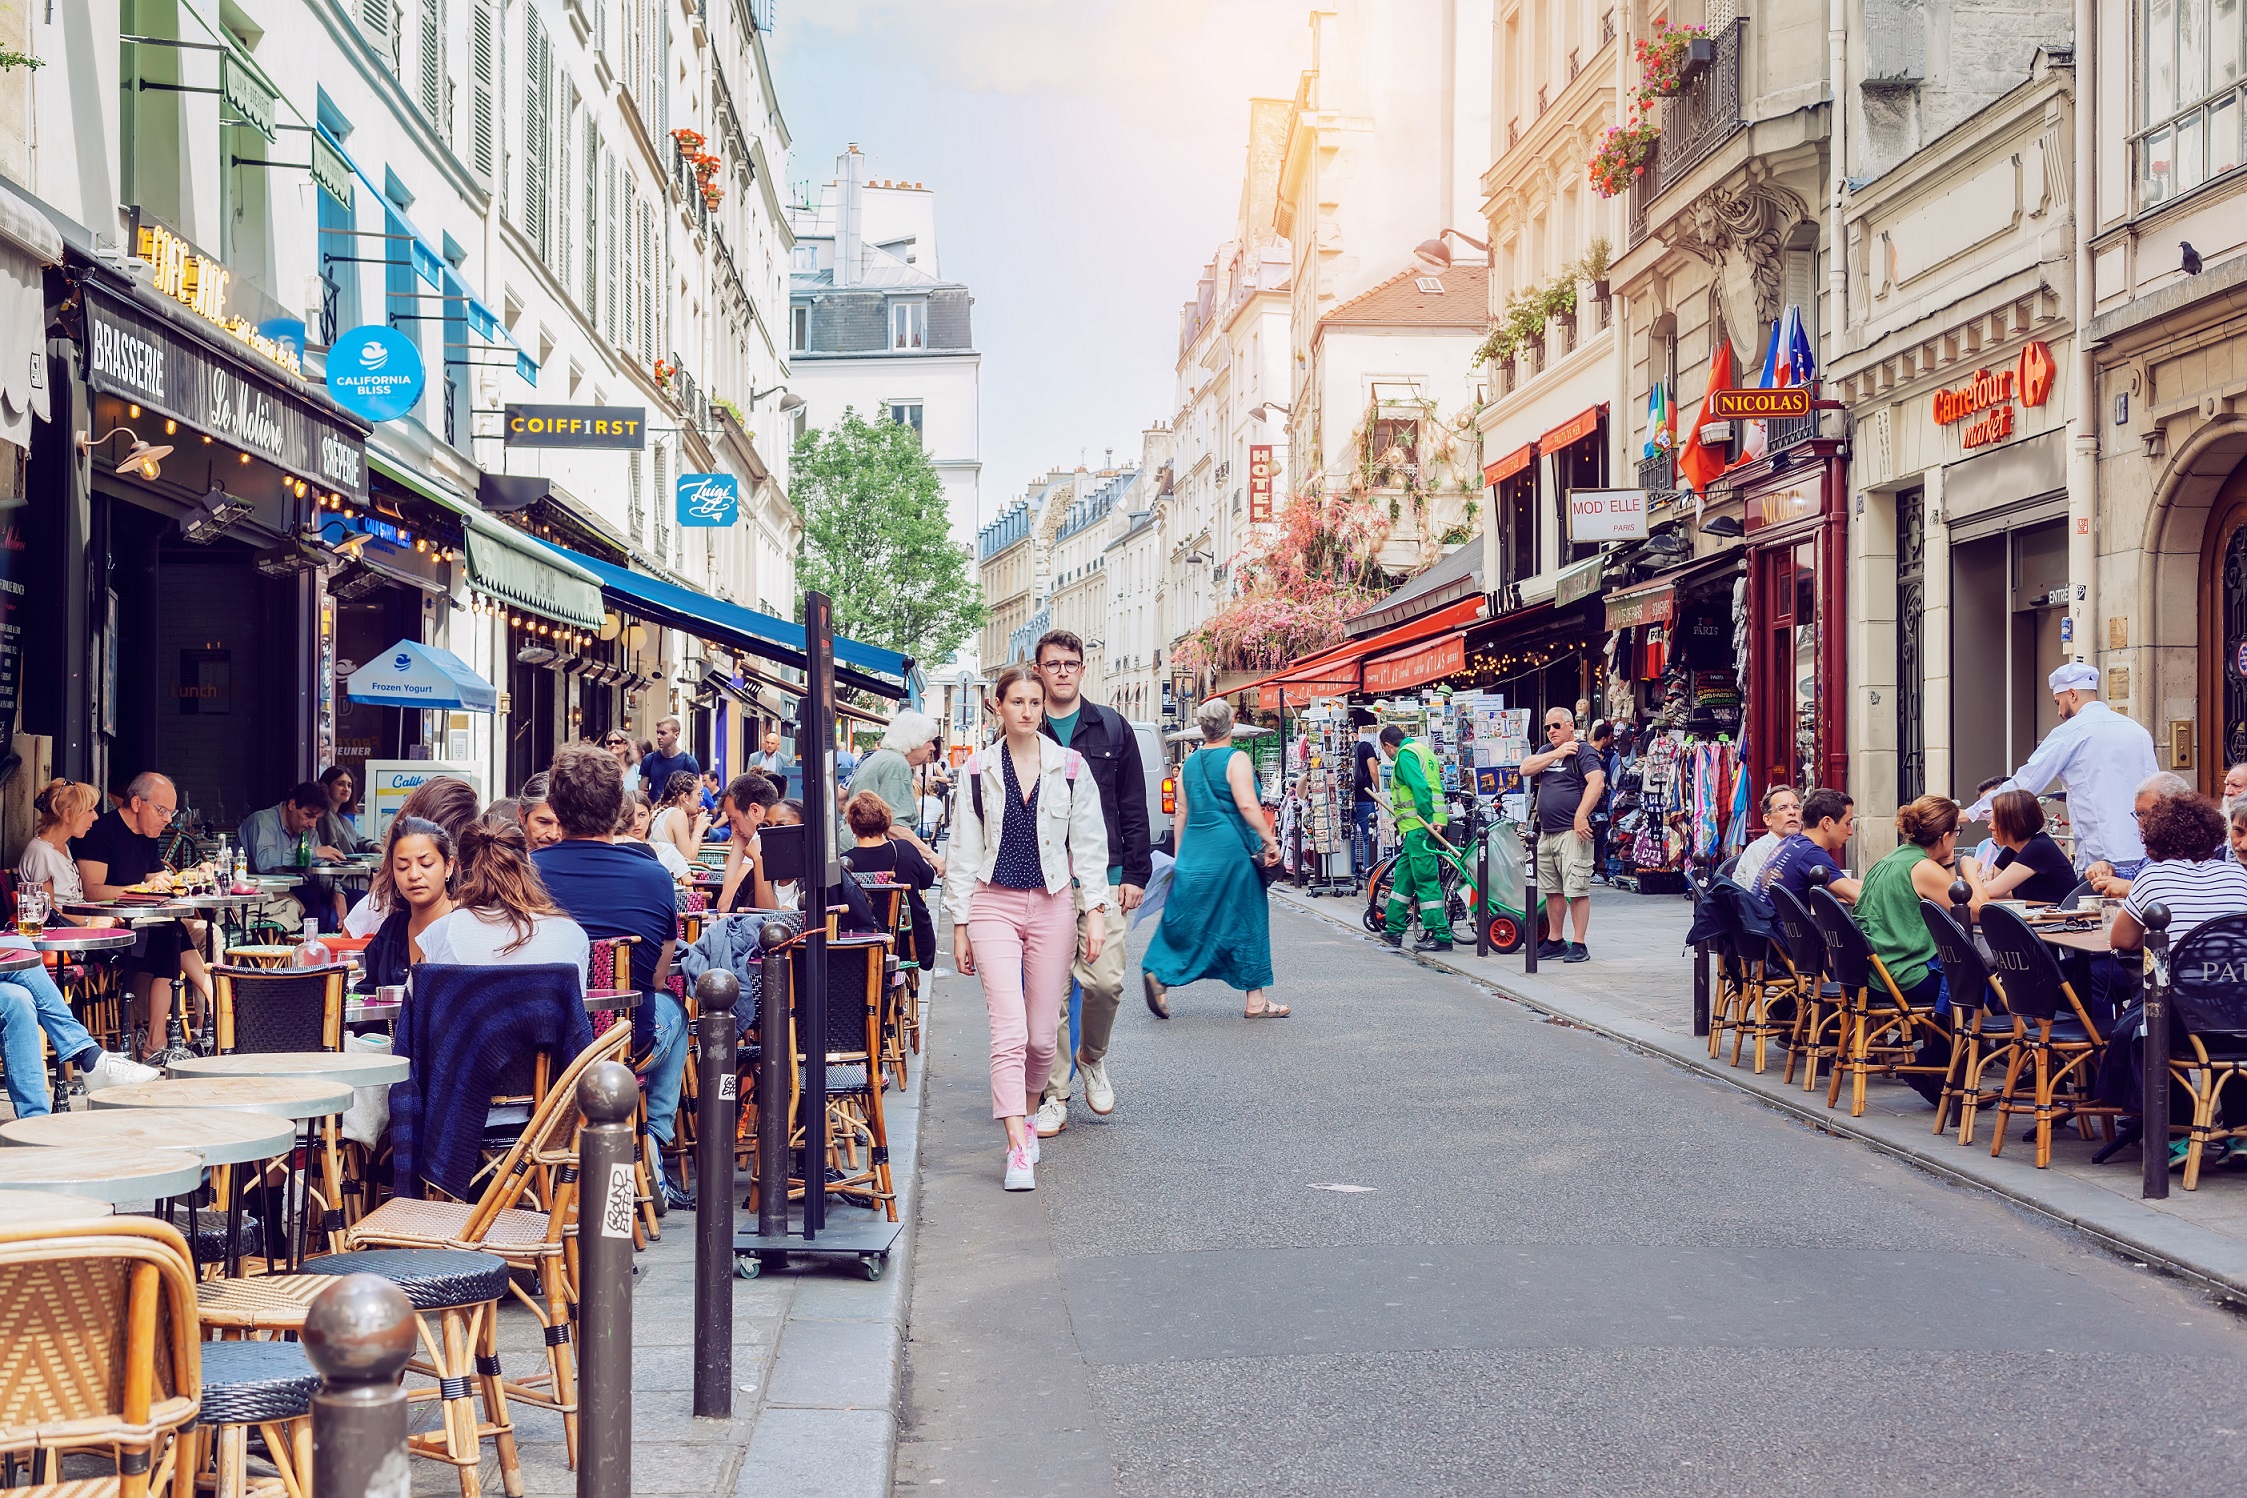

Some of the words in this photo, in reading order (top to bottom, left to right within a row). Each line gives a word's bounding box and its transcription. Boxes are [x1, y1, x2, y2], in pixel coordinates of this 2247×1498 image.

[336, 375, 412, 386] CALIFORNIA
[357, 385, 391, 395] BLISS
[1932, 368, 2014, 426] Carrefour
[93, 318, 165, 398] BRASSERIE
[211, 366, 232, 430] Le
[231, 380, 284, 455] Molière
[321, 433, 361, 489] CRÊPERIE
[1721, 394, 1803, 412] NICOLAS
[510, 417, 639, 436] COIFF1RST
[1962, 405, 2014, 449] market
[1252, 449, 1270, 519] HOTEL
[679, 477, 735, 514] Luigi
[1610, 498, 1641, 513] ELLE
[1613, 523, 1635, 532] PARIS
[1693, 626, 1719, 636] PARIS
[1425, 652, 1446, 674] ATLAS
[372, 682, 401, 692] Frozen
[403, 684, 433, 694] Yogurt
[1782, 922, 1802, 938] AUL
[1824, 930, 1844, 948] AUL
[1936, 944, 1962, 963] AUL
[1992, 949, 2030, 971] PAUL
